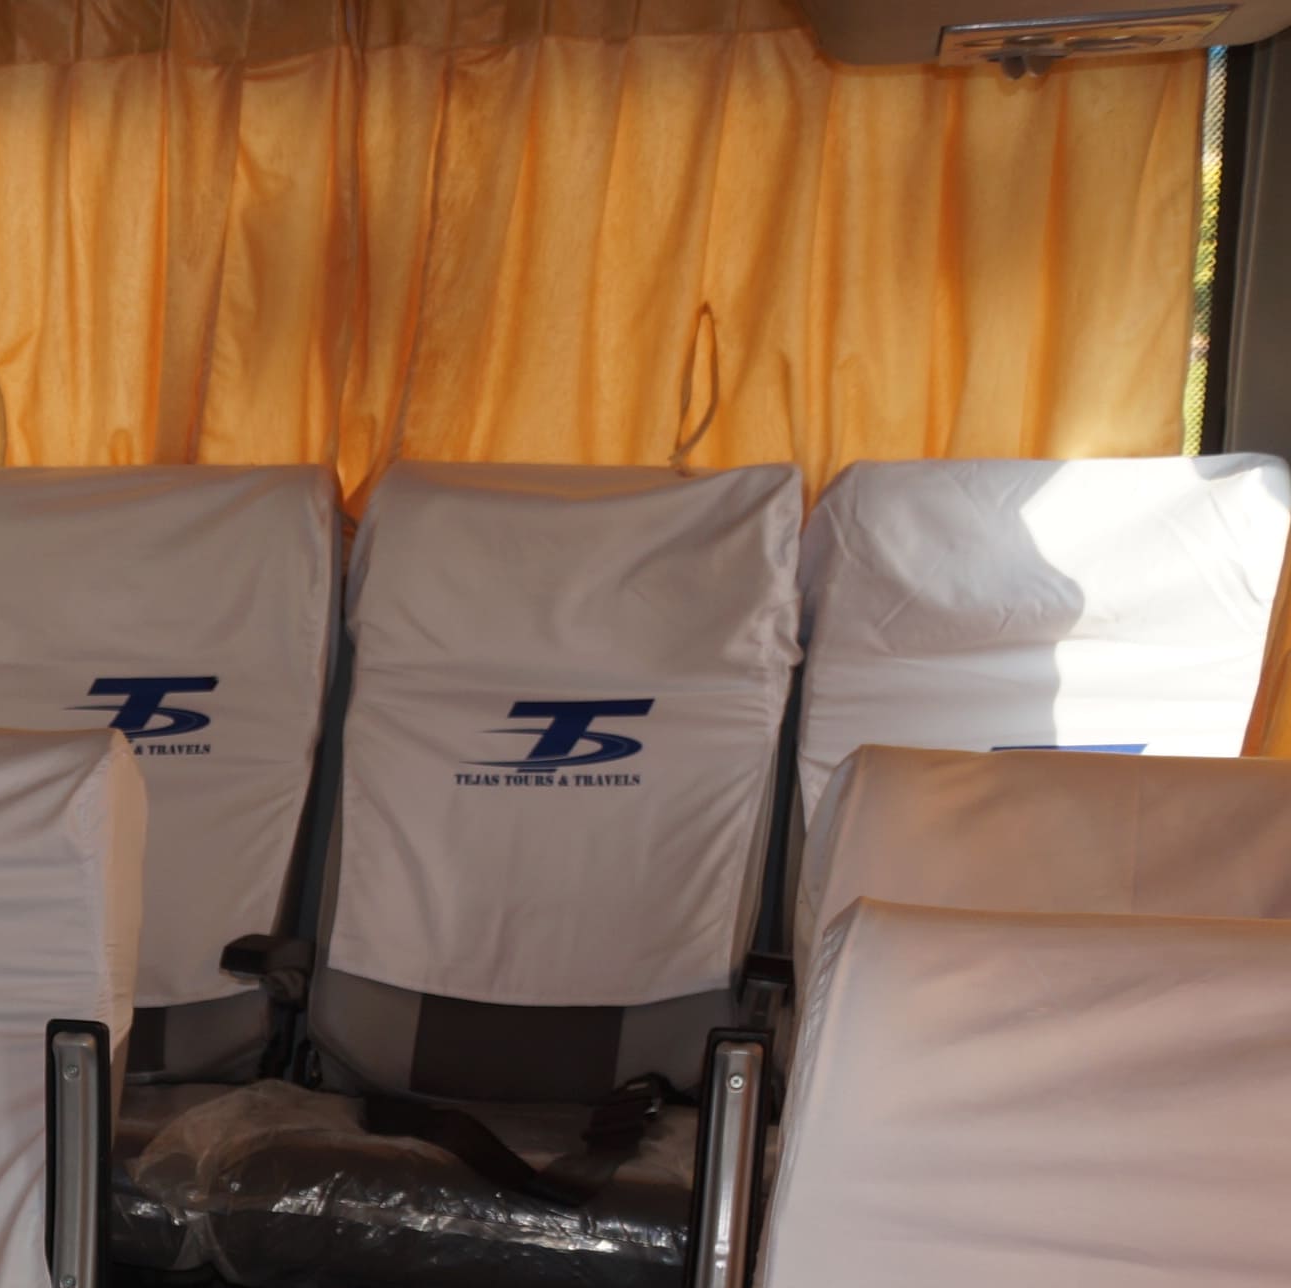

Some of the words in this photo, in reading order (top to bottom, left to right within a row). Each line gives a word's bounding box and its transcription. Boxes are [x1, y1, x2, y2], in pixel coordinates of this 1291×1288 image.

[133, 745, 144, 756] &
[147, 744, 212, 756] TRAVELS
[455, 774, 500, 787] TEJAS
[504, 774, 555, 787] TOURS
[557, 774, 570, 787] &
[573, 774, 641, 787] TRAVELS
